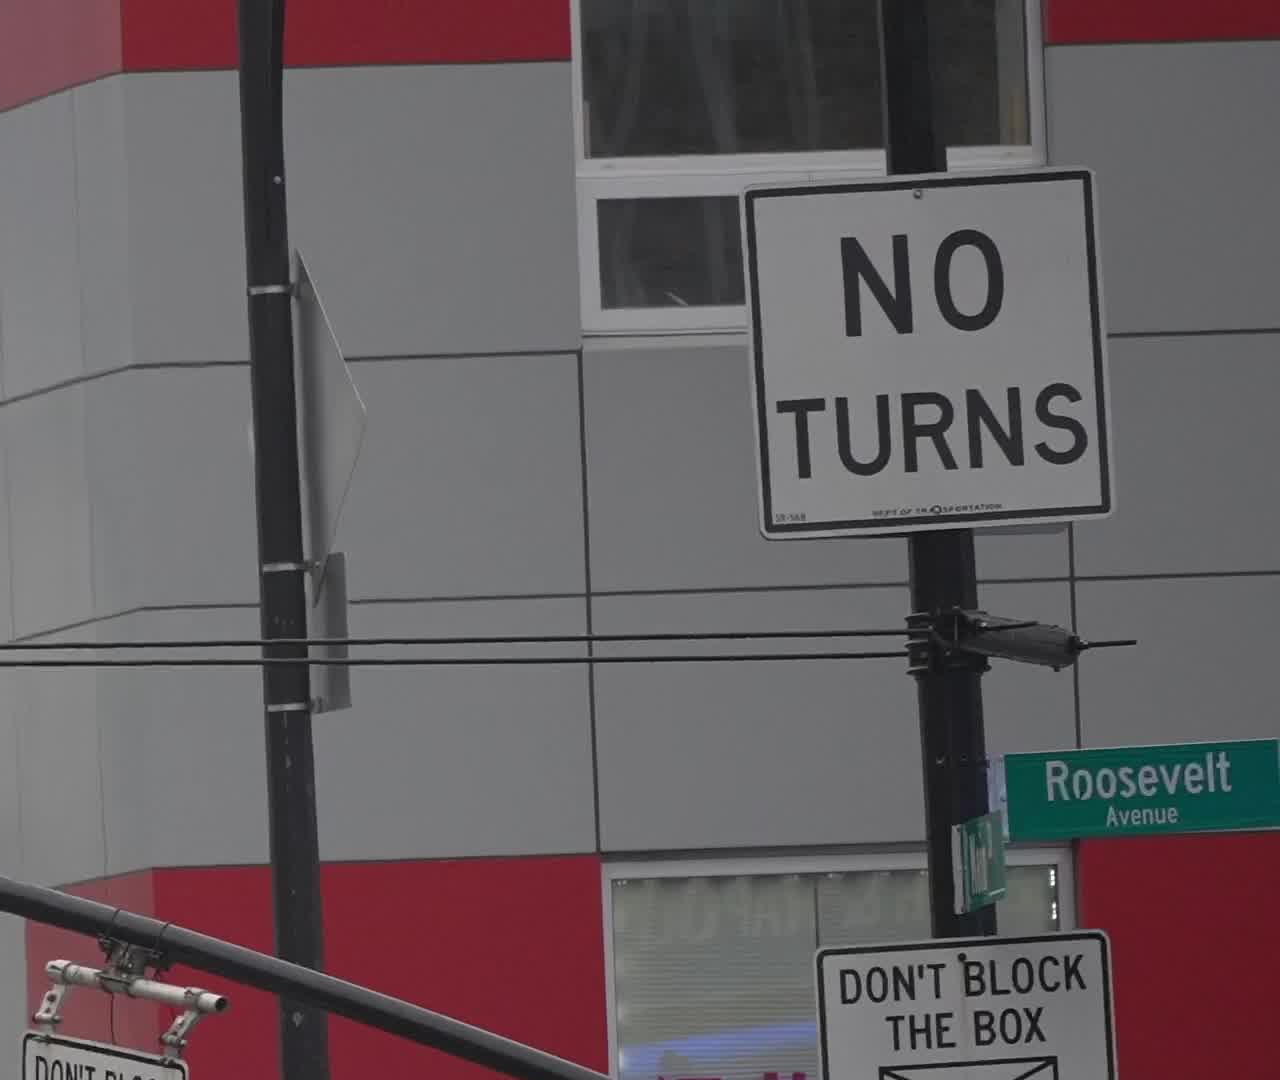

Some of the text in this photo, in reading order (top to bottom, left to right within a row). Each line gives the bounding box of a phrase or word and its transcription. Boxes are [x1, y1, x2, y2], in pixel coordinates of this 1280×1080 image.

[840, 228, 1004, 337] NO
[775, 382, 1088, 480] TURNS
[1045, 752, 1233, 801] Roosevelt
[1106, 806, 1178, 827] Avenue
[840, 955, 1087, 1005] DON'T BLOCK
[886, 1007, 1047, 1051] THE BOX
